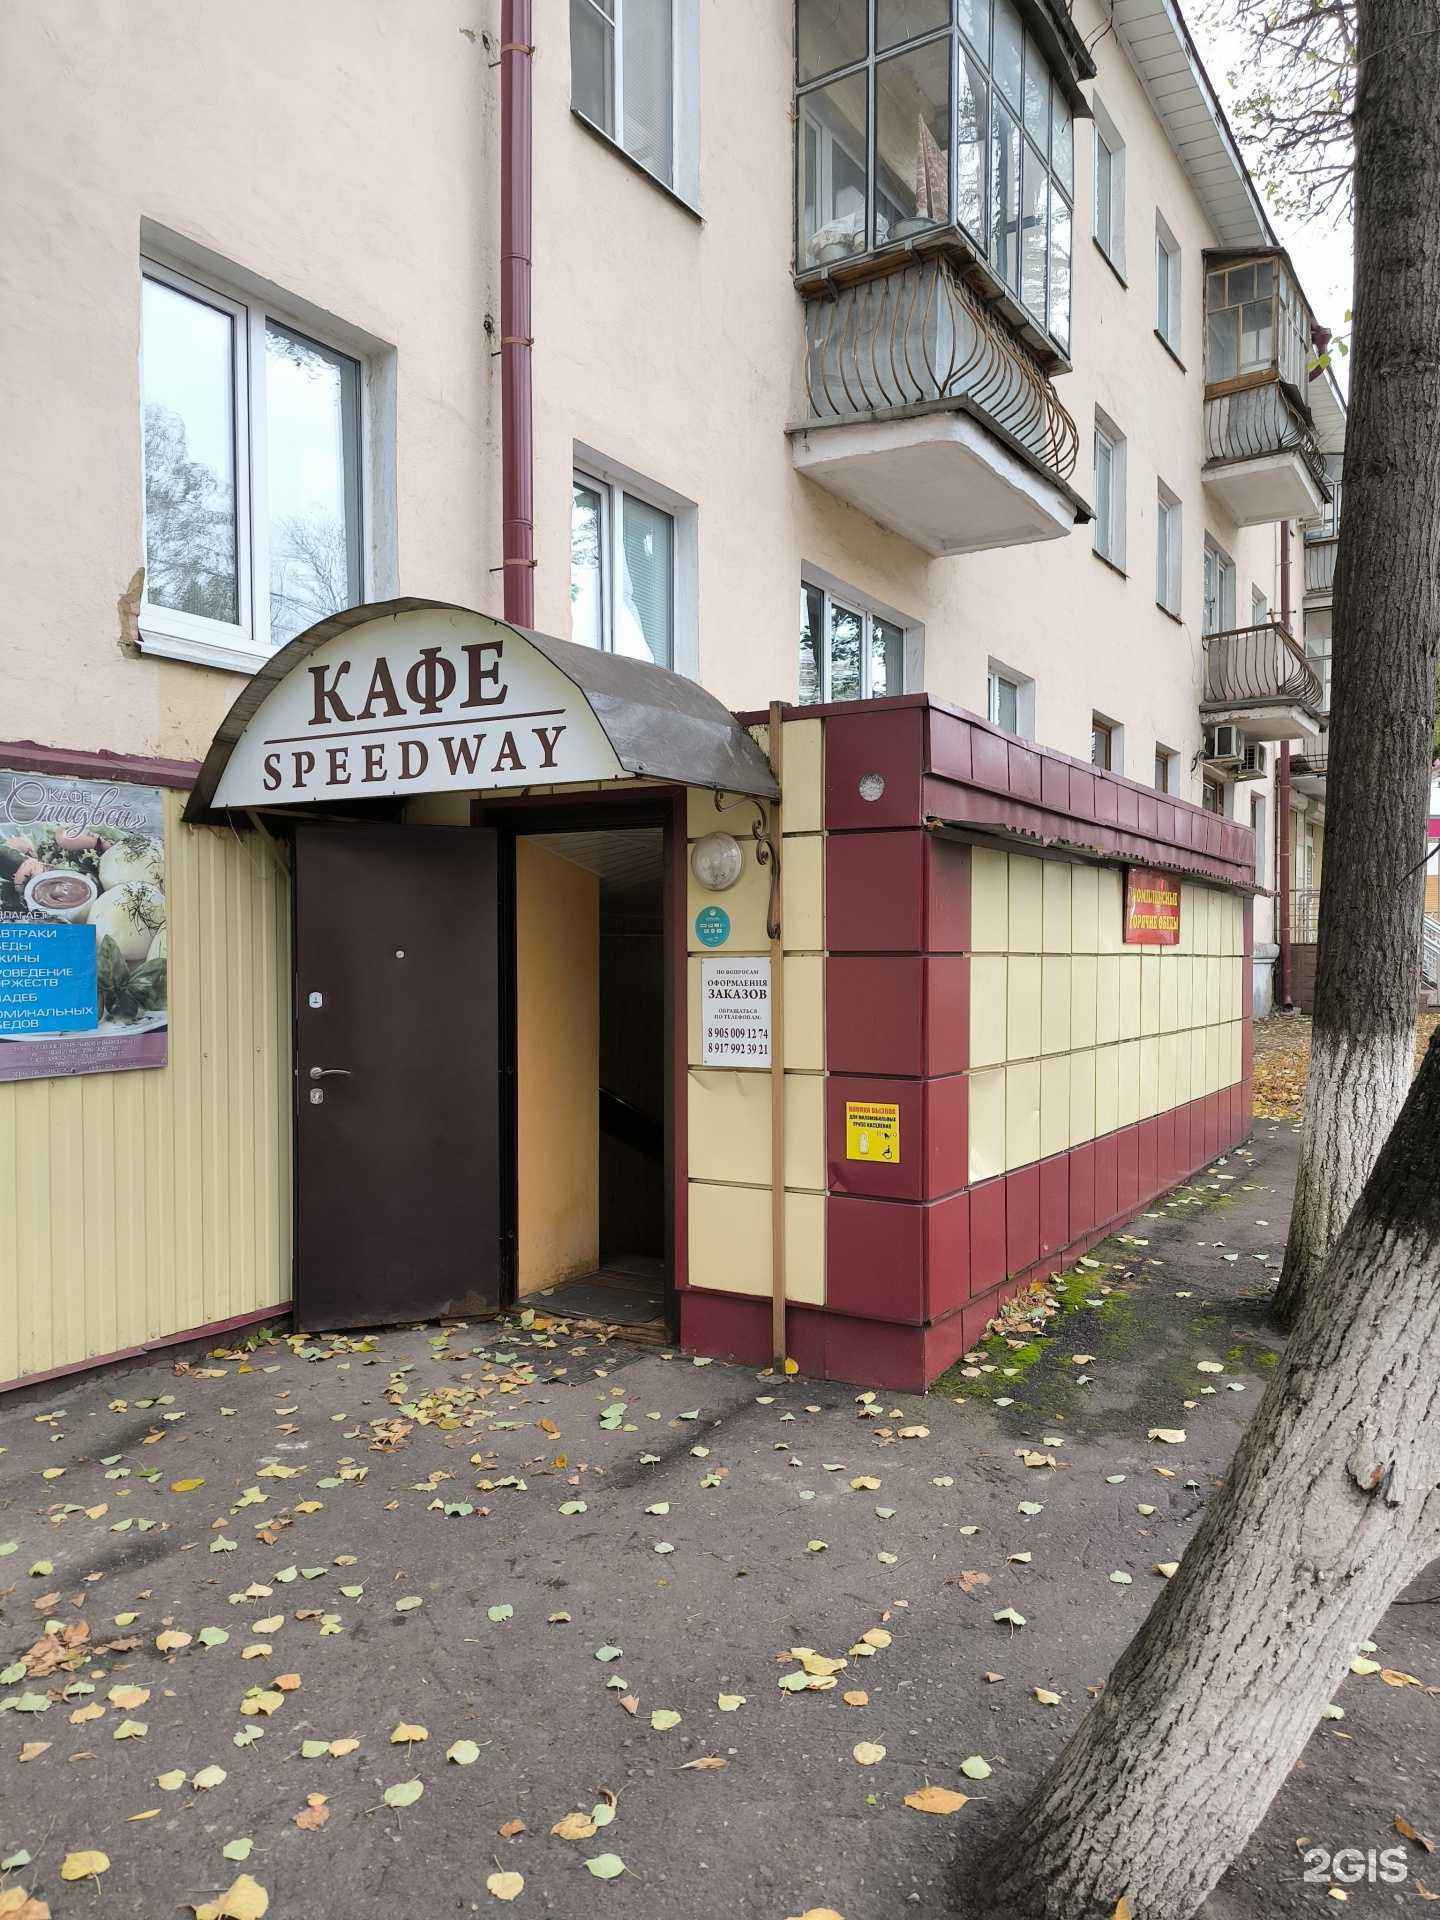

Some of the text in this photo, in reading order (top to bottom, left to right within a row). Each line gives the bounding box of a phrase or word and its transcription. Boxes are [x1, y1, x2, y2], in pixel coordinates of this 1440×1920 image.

[308, 640, 508, 726] КАФЕ
[263, 726, 567, 791] SPEEDWAY
[47, 788, 91, 804] КАФЕ
[0, 929, 57, 938] ВТРАКИ
[0, 942, 32, 951] ЕДЫ
[0, 968, 73, 978] ОВЕДЕНИЕ
[0, 979, 58, 988] РЖЕСТВ
[707, 979, 768, 987] ОФОРМЛЕНИЯ
[0, 993, 38, 1003] АДЕБ
[708, 988, 767, 1000] ЗАКАЗОВ
[0, 1019, 39, 1030] ЕДОВ
[708, 1027, 768, 1039] 8 905 009 12 74
[708, 1042, 713, 1054] 8
